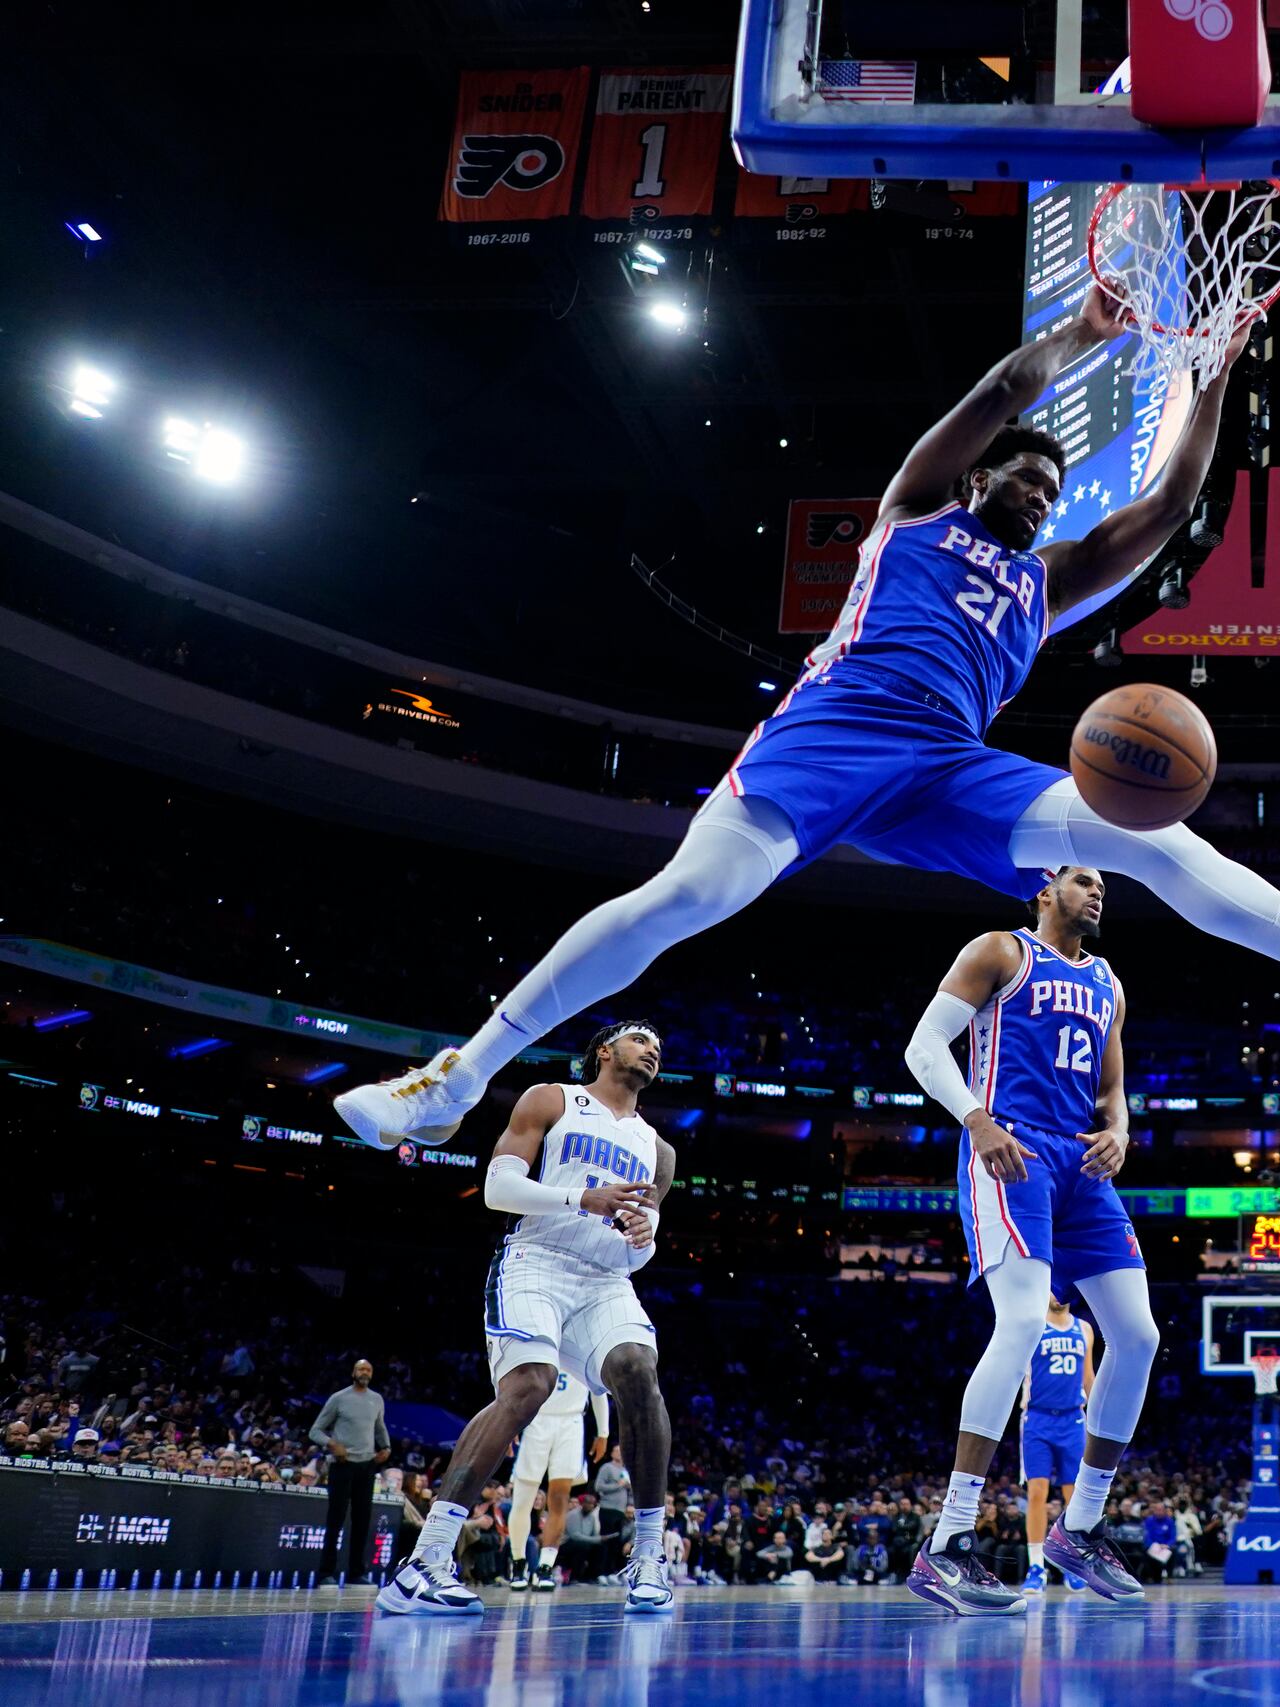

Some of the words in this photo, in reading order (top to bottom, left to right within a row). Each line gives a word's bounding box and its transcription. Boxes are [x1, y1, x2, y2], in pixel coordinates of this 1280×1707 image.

[640, 80, 686, 91] BERNIE
[479, 93, 563, 112] SNIDER
[618, 90, 705, 110] PARENT
[632, 123, 667, 198] 1
[1044, 196, 1071, 218] HARRIS
[468, 232, 531, 245] 1967-2016
[643, 227, 693, 240] 1973-79
[1044, 223, 1072, 247] MELTON
[1043, 238, 1073, 262] HARDEN
[1032, 279, 1053, 296] TEAM
[1054, 262, 1081, 284] TOTALS
[1062, 288, 1086, 307] TEAM
[1054, 377, 1077, 394] TEAM
[1077, 350, 1110, 381] LEADERS
[955, 574, 1013, 637] 21
[1143, 634, 1252, 647] FARGO
[1031, 979, 1112, 1038] PHILA
[1055, 1025, 1092, 1073] 12
[103, 1096, 160, 1118] BETMGM
[266, 1125, 323, 1146] BETMGM
[1040, 1336, 1085, 1357] PHILA
[1049, 1354, 1077, 1375] 20
[557, 1373, 567, 1391] 5
[14, 1457, 50, 1469] BIOSTEEL
